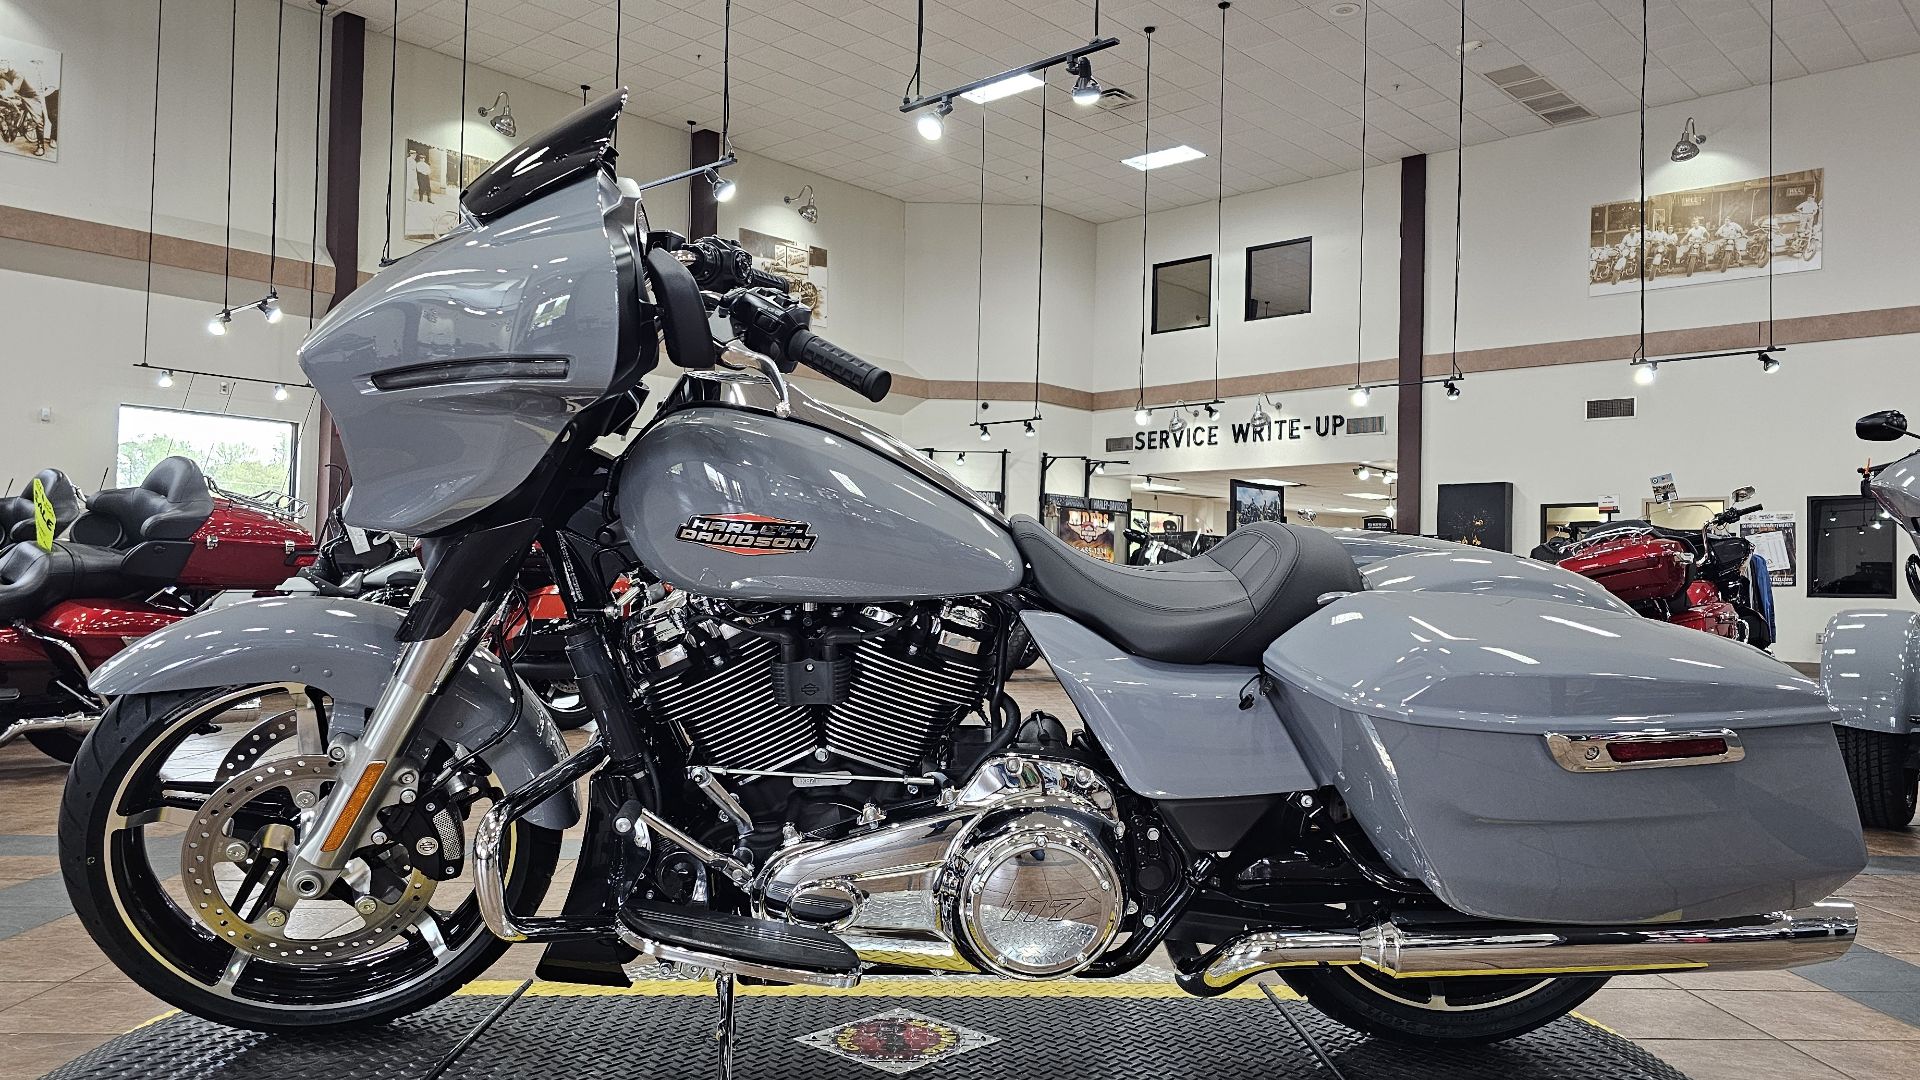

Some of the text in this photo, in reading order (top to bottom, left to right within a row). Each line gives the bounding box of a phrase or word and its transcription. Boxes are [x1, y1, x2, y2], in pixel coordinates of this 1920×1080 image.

[1134, 414, 1345, 450] SERVICE WRITE-UP
[679, 528, 811, 549] DAVIDSON
[1002, 897, 1086, 923] 117
